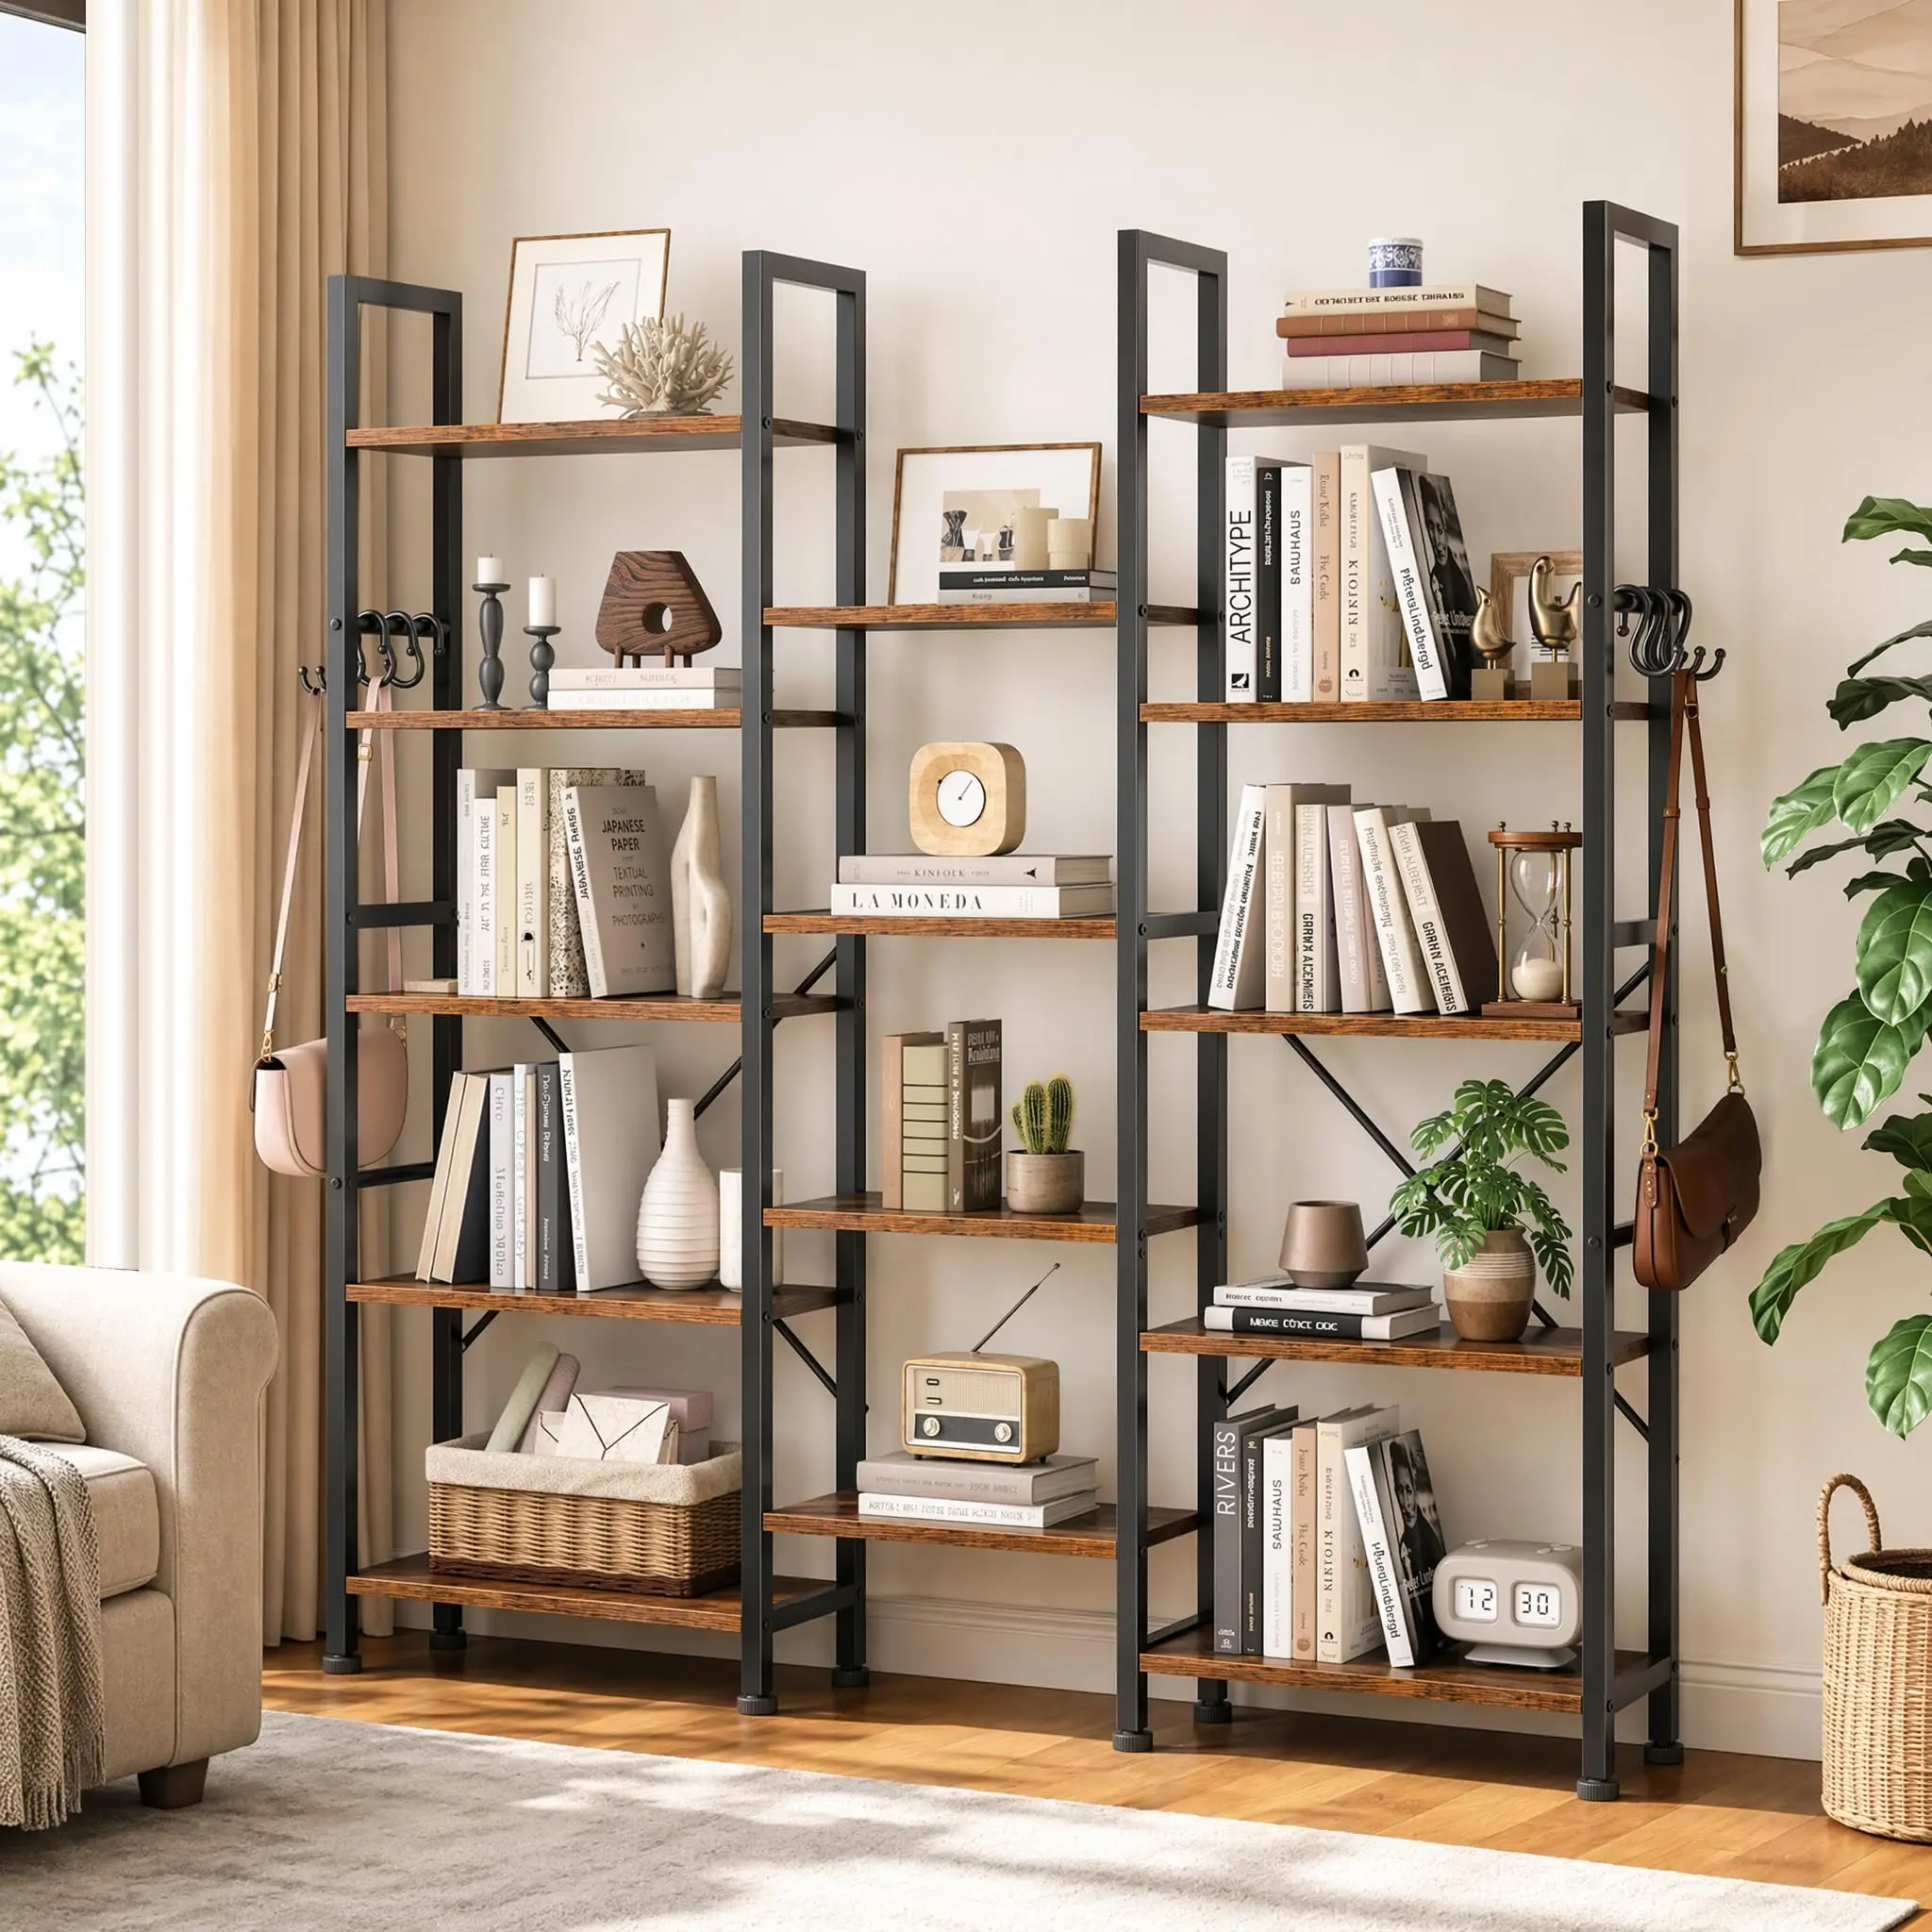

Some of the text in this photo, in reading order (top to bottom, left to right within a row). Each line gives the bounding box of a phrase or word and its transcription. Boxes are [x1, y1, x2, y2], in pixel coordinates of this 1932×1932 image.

[1230, 509, 1252, 644] ARCHITYPE
[602, 819, 646, 834] JAPANESE
[611, 837, 641, 851] PAPER
[612, 866, 648, 880] TEXTUAL
[914, 868, 965, 877] KINFOLK
[612, 885, 655, 898] PRINTING
[852, 892, 983, 909] LA MONEDA
[1217, 1430, 1236, 1516] RIVERS
[1470, 1588, 1549, 1616] 12 30
